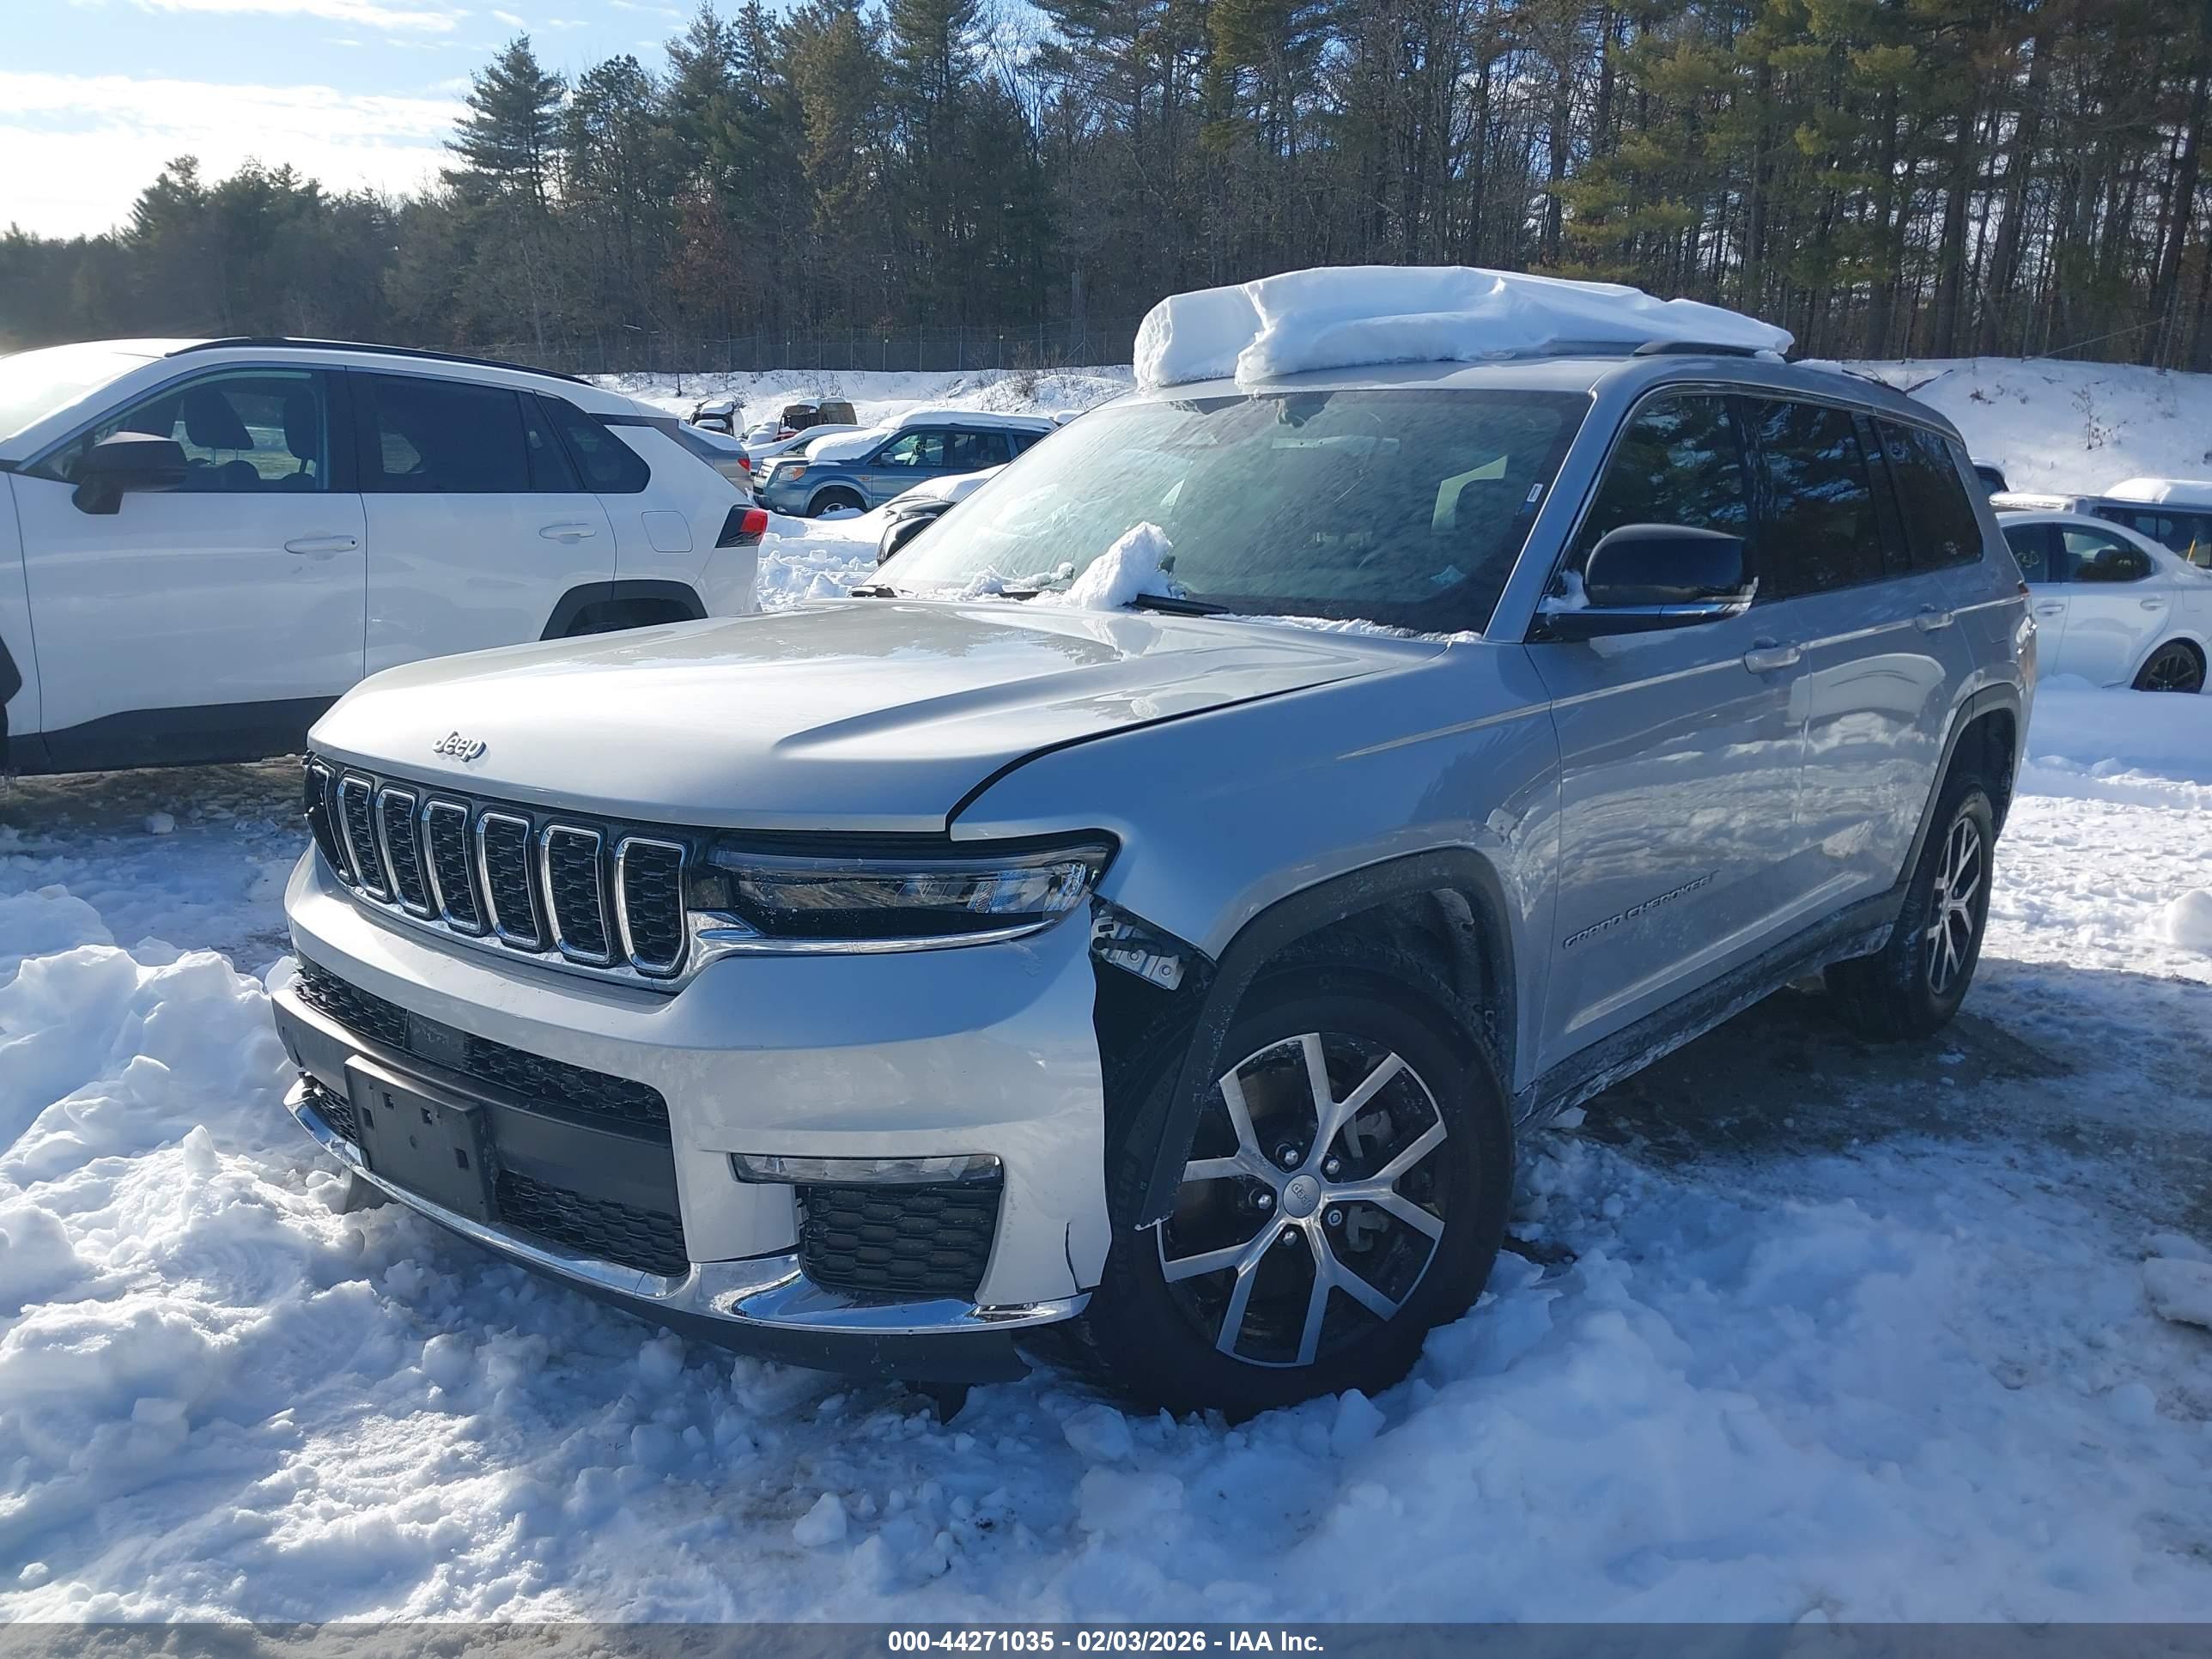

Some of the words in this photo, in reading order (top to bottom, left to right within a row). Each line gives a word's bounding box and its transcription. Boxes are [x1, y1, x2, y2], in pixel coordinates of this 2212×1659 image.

[432, 730, 488, 763] Jeep
[1563, 914, 1622, 948] GRAND
[1626, 877, 1710, 921] CHEROKEE
[1291, 1183, 1312, 1209] Jeep
